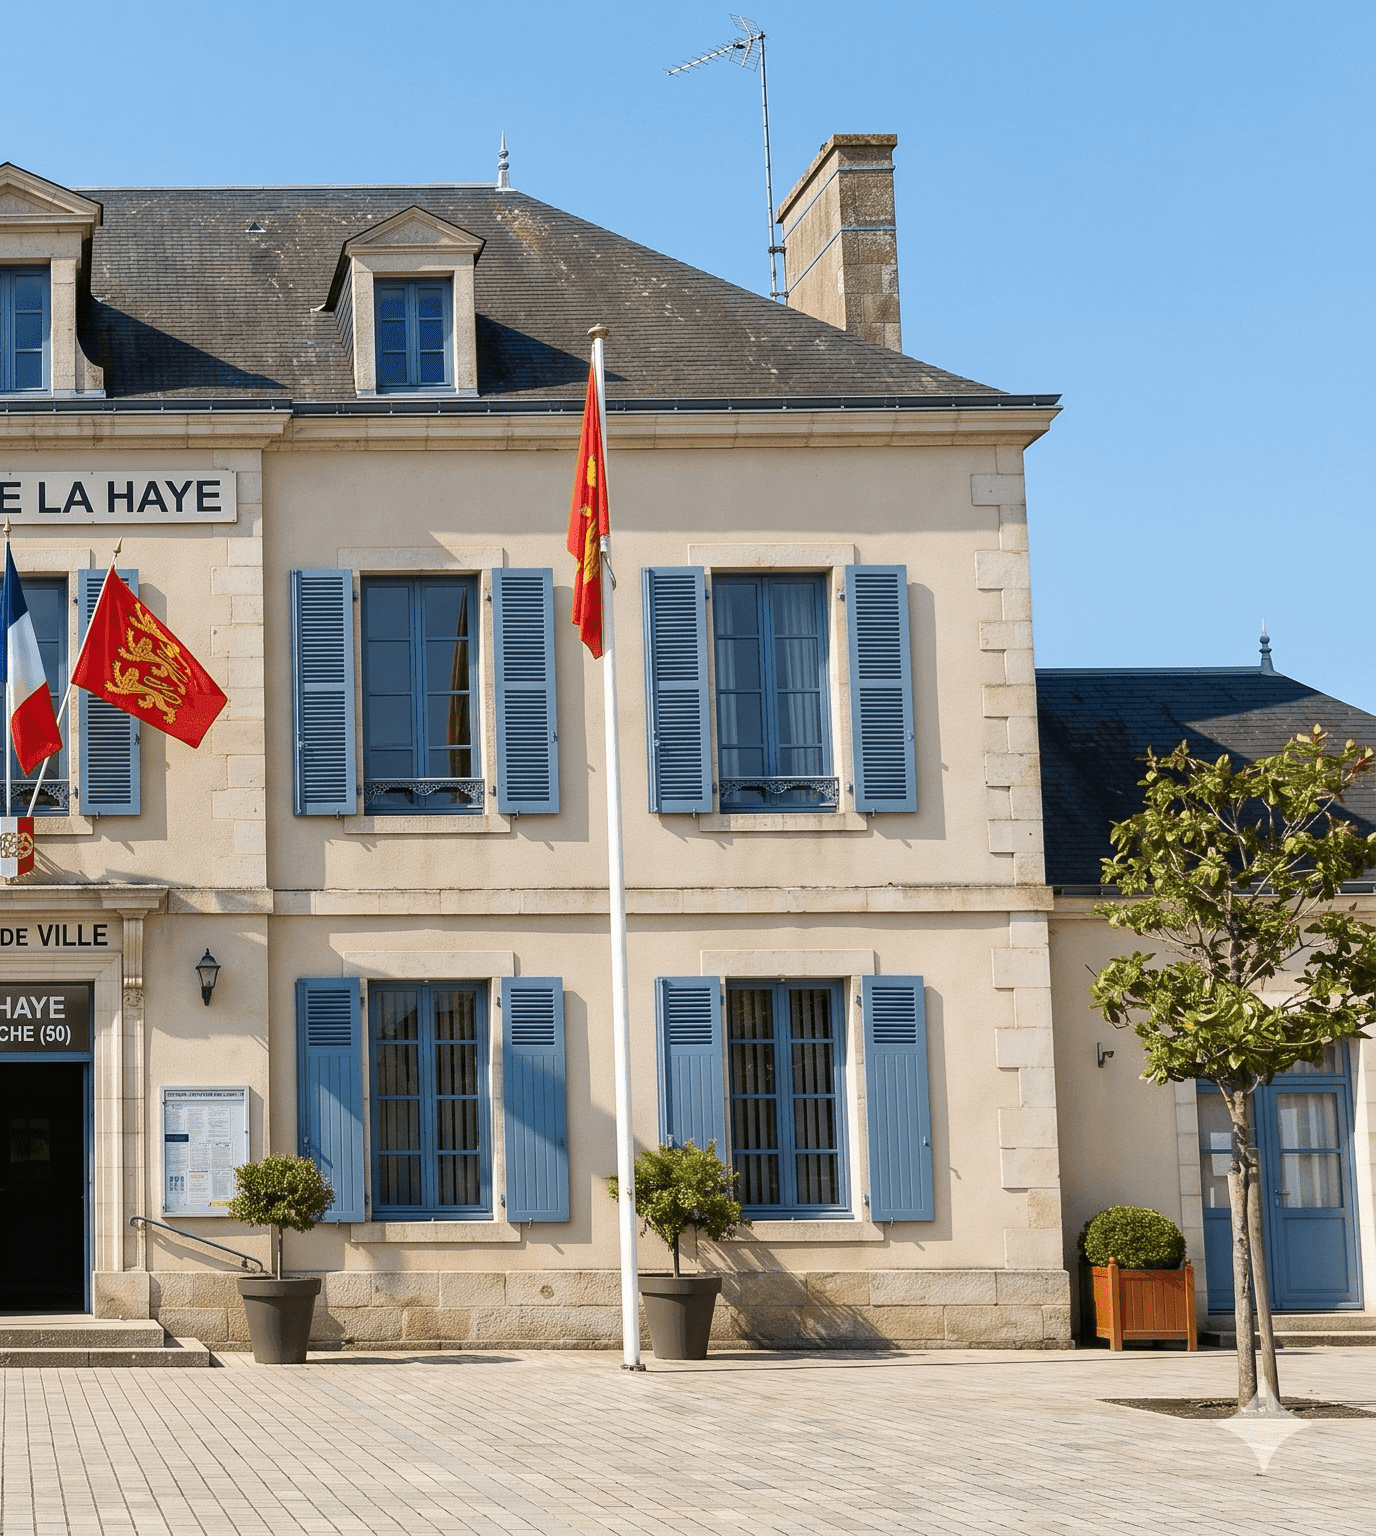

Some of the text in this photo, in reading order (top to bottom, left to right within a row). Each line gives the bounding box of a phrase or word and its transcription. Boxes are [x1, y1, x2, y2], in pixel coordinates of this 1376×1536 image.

[38, 481, 95, 514] LA
[107, 479, 222, 513] HAYE
[0, 928, 29, 947] DE
[37, 924, 109, 947] VILLE
[40, 1025, 71, 1046] (50)
